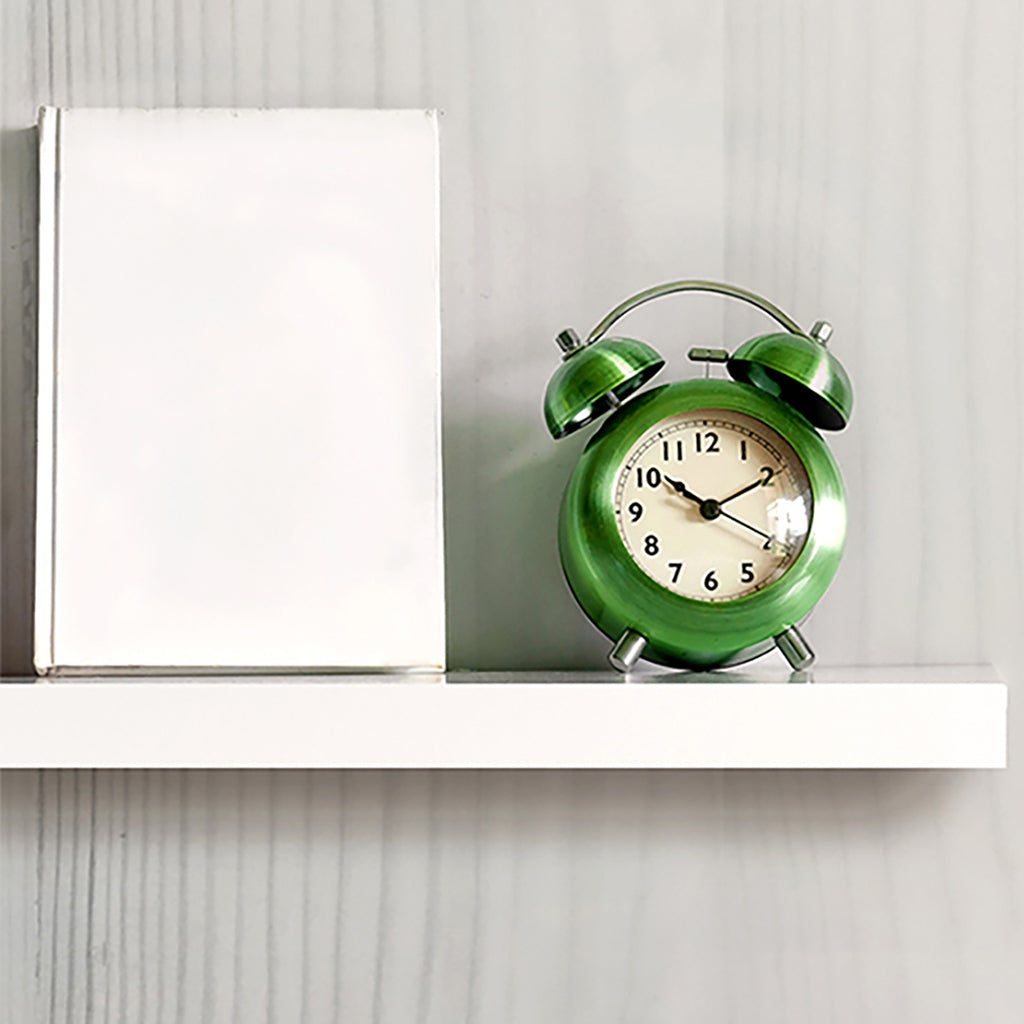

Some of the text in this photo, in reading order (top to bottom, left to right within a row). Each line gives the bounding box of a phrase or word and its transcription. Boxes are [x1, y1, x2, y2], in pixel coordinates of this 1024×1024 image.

[663, 441, 683, 461] 11
[695, 432, 720, 452] 12
[741, 440, 747, 461] 1
[637, 467, 661, 488] 10
[628, 502, 643, 522] 9
[644, 535, 659, 556] 8
[668, 563, 682, 583] 7
[704, 571, 719, 591] 6
[741, 563, 754, 583] 5
